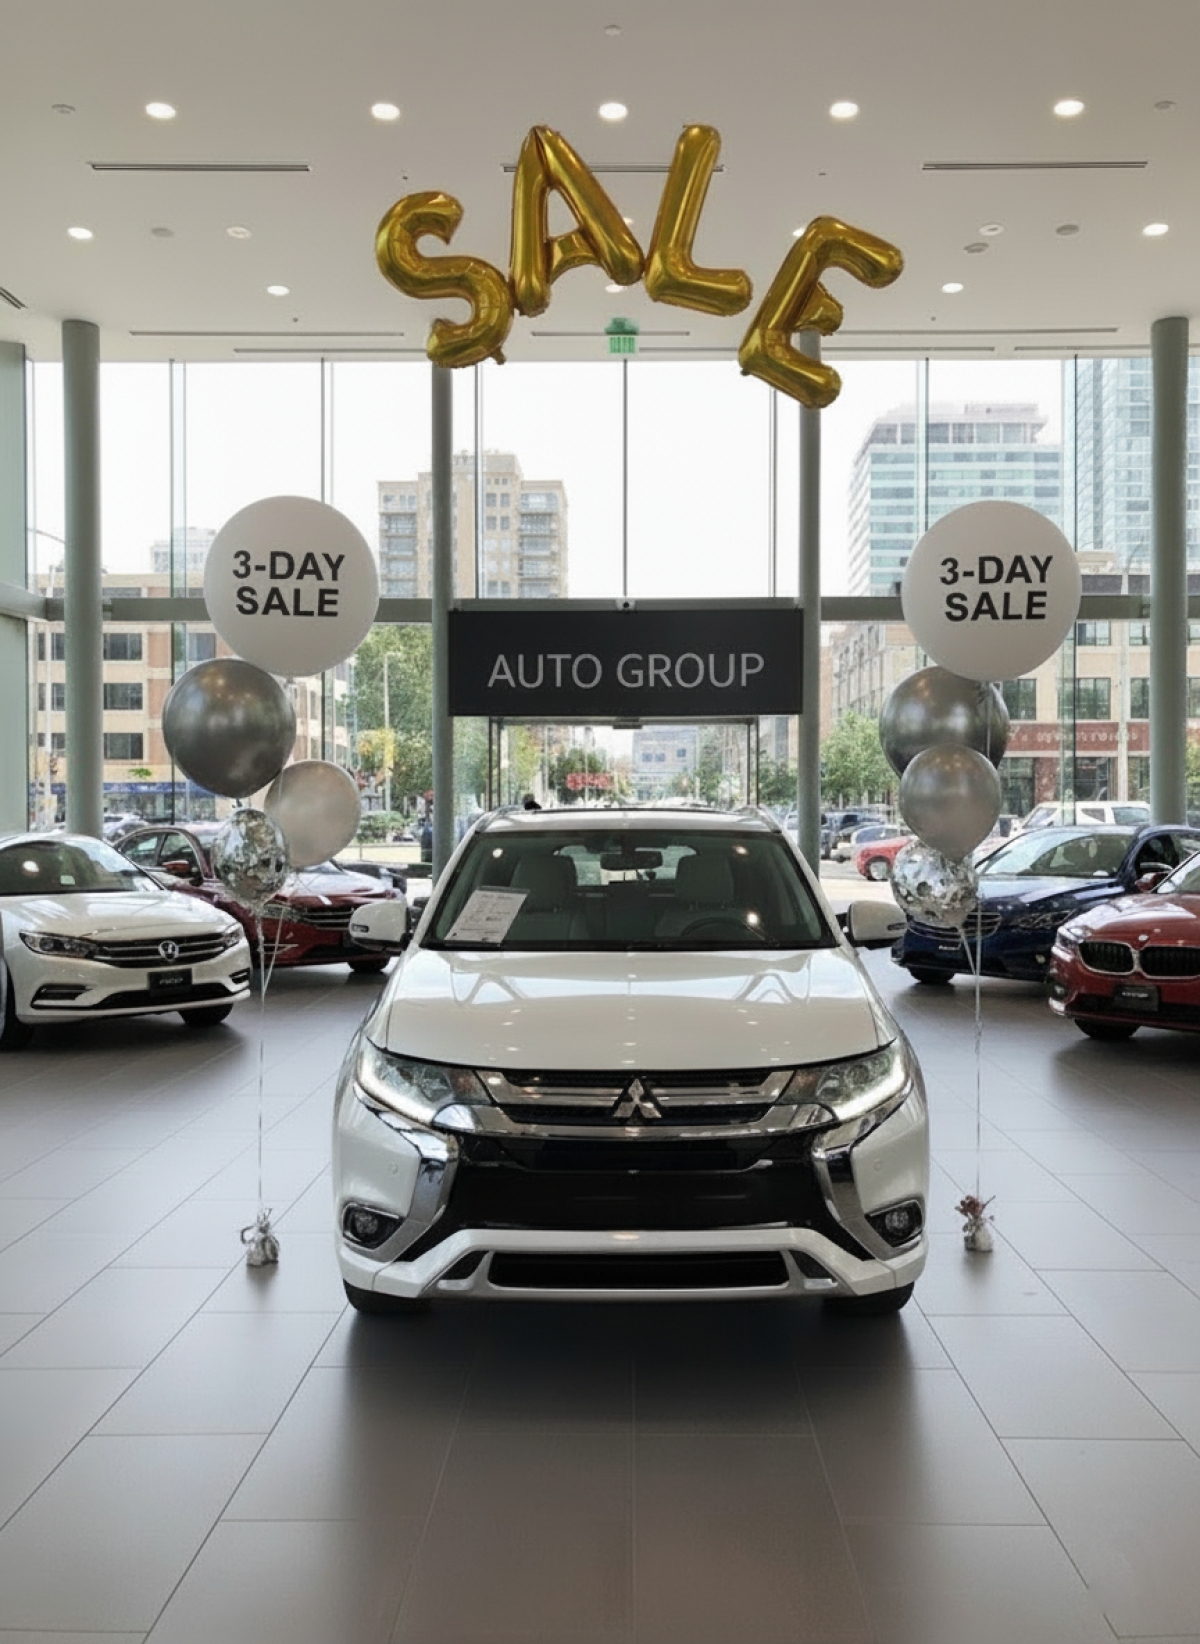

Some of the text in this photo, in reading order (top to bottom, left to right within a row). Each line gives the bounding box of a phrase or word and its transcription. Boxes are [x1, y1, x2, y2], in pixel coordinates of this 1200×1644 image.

[375, 124, 904, 409] SALE
[232, 549, 345, 581] 3-DAY
[939, 555, 1053, 585] 3-DAY
[236, 586, 339, 617] SALE
[945, 591, 1047, 622] SALE
[487, 653, 765, 689] AUTO GROUP
